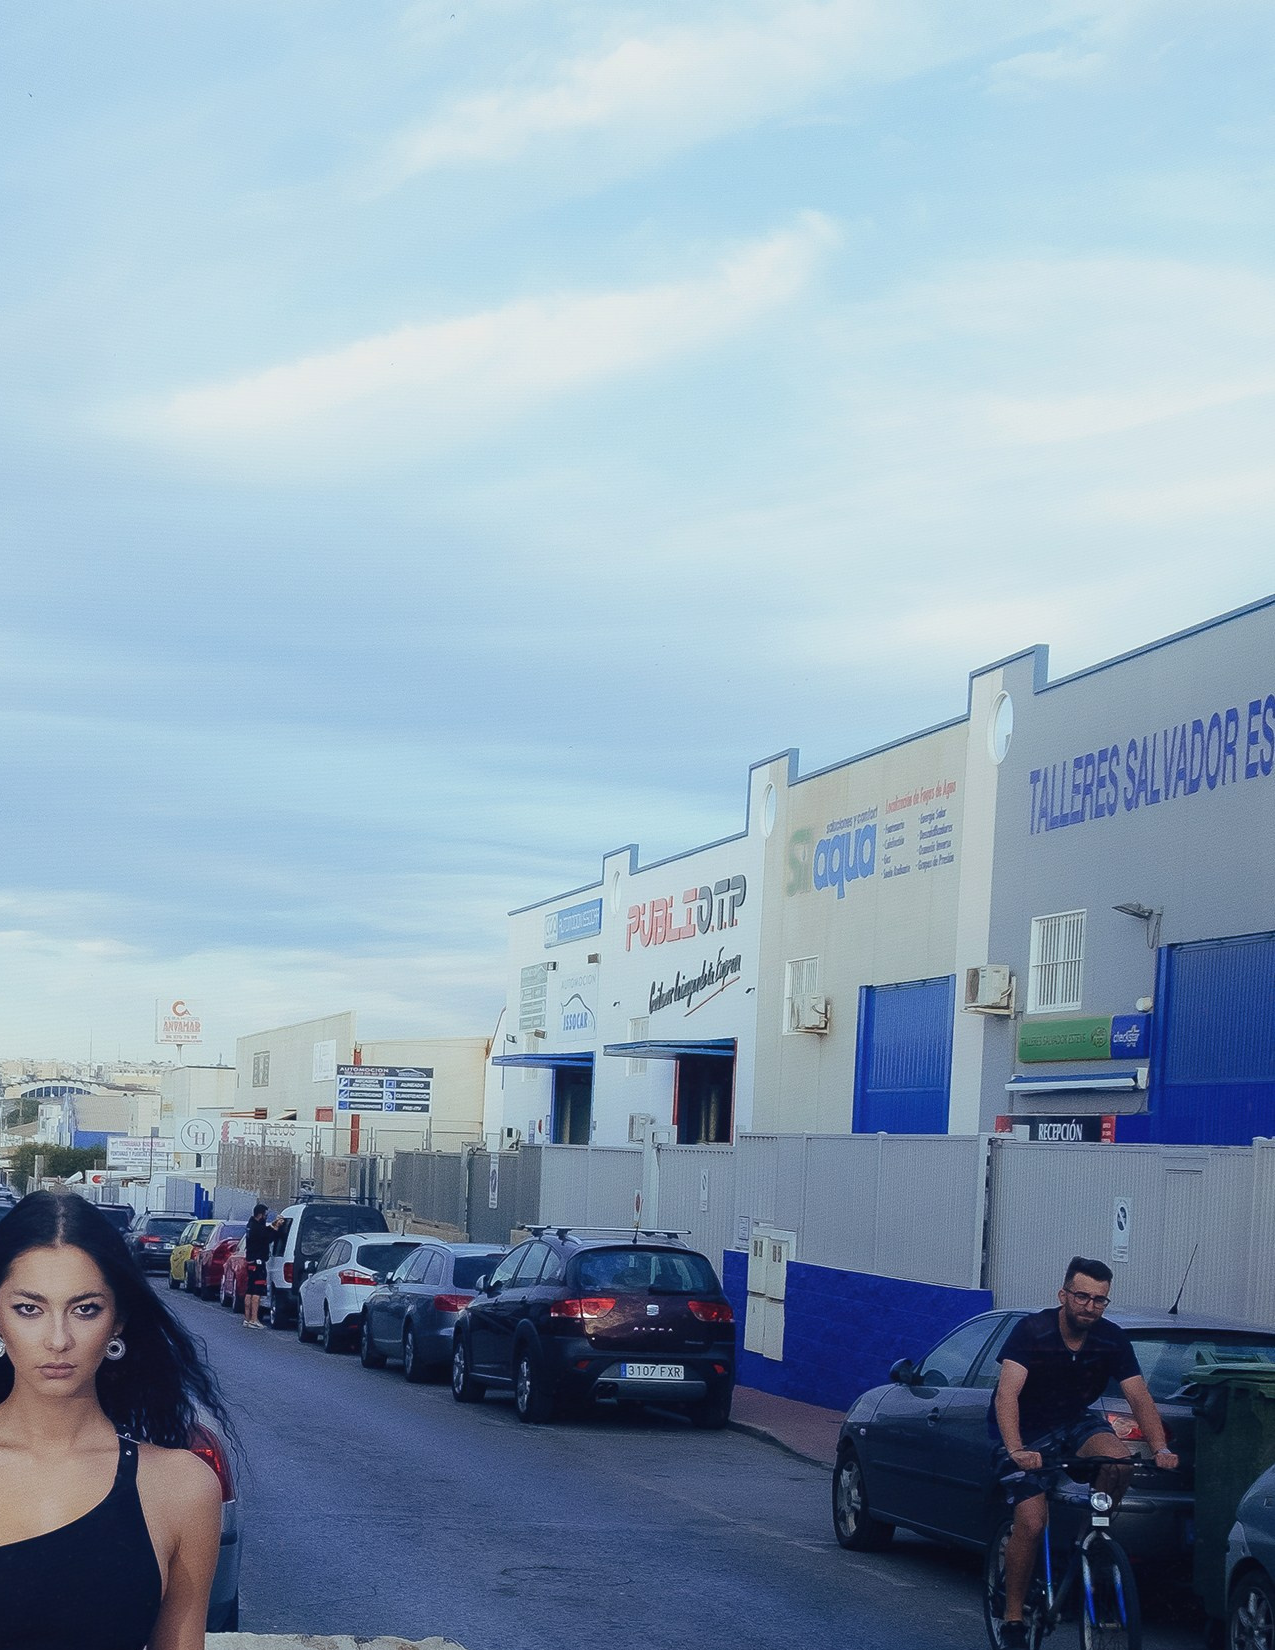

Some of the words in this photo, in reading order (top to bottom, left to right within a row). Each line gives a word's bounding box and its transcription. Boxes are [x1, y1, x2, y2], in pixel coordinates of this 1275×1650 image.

[1030, 744, 1120, 836] TALLERES
[1123, 706, 1239, 812] SALVADOR
[1038, 1118, 1084, 1141] RECEPCIÓN
[627, 1365, 656, 1377] 3107
[660, 1366, 681, 1378] FXR
